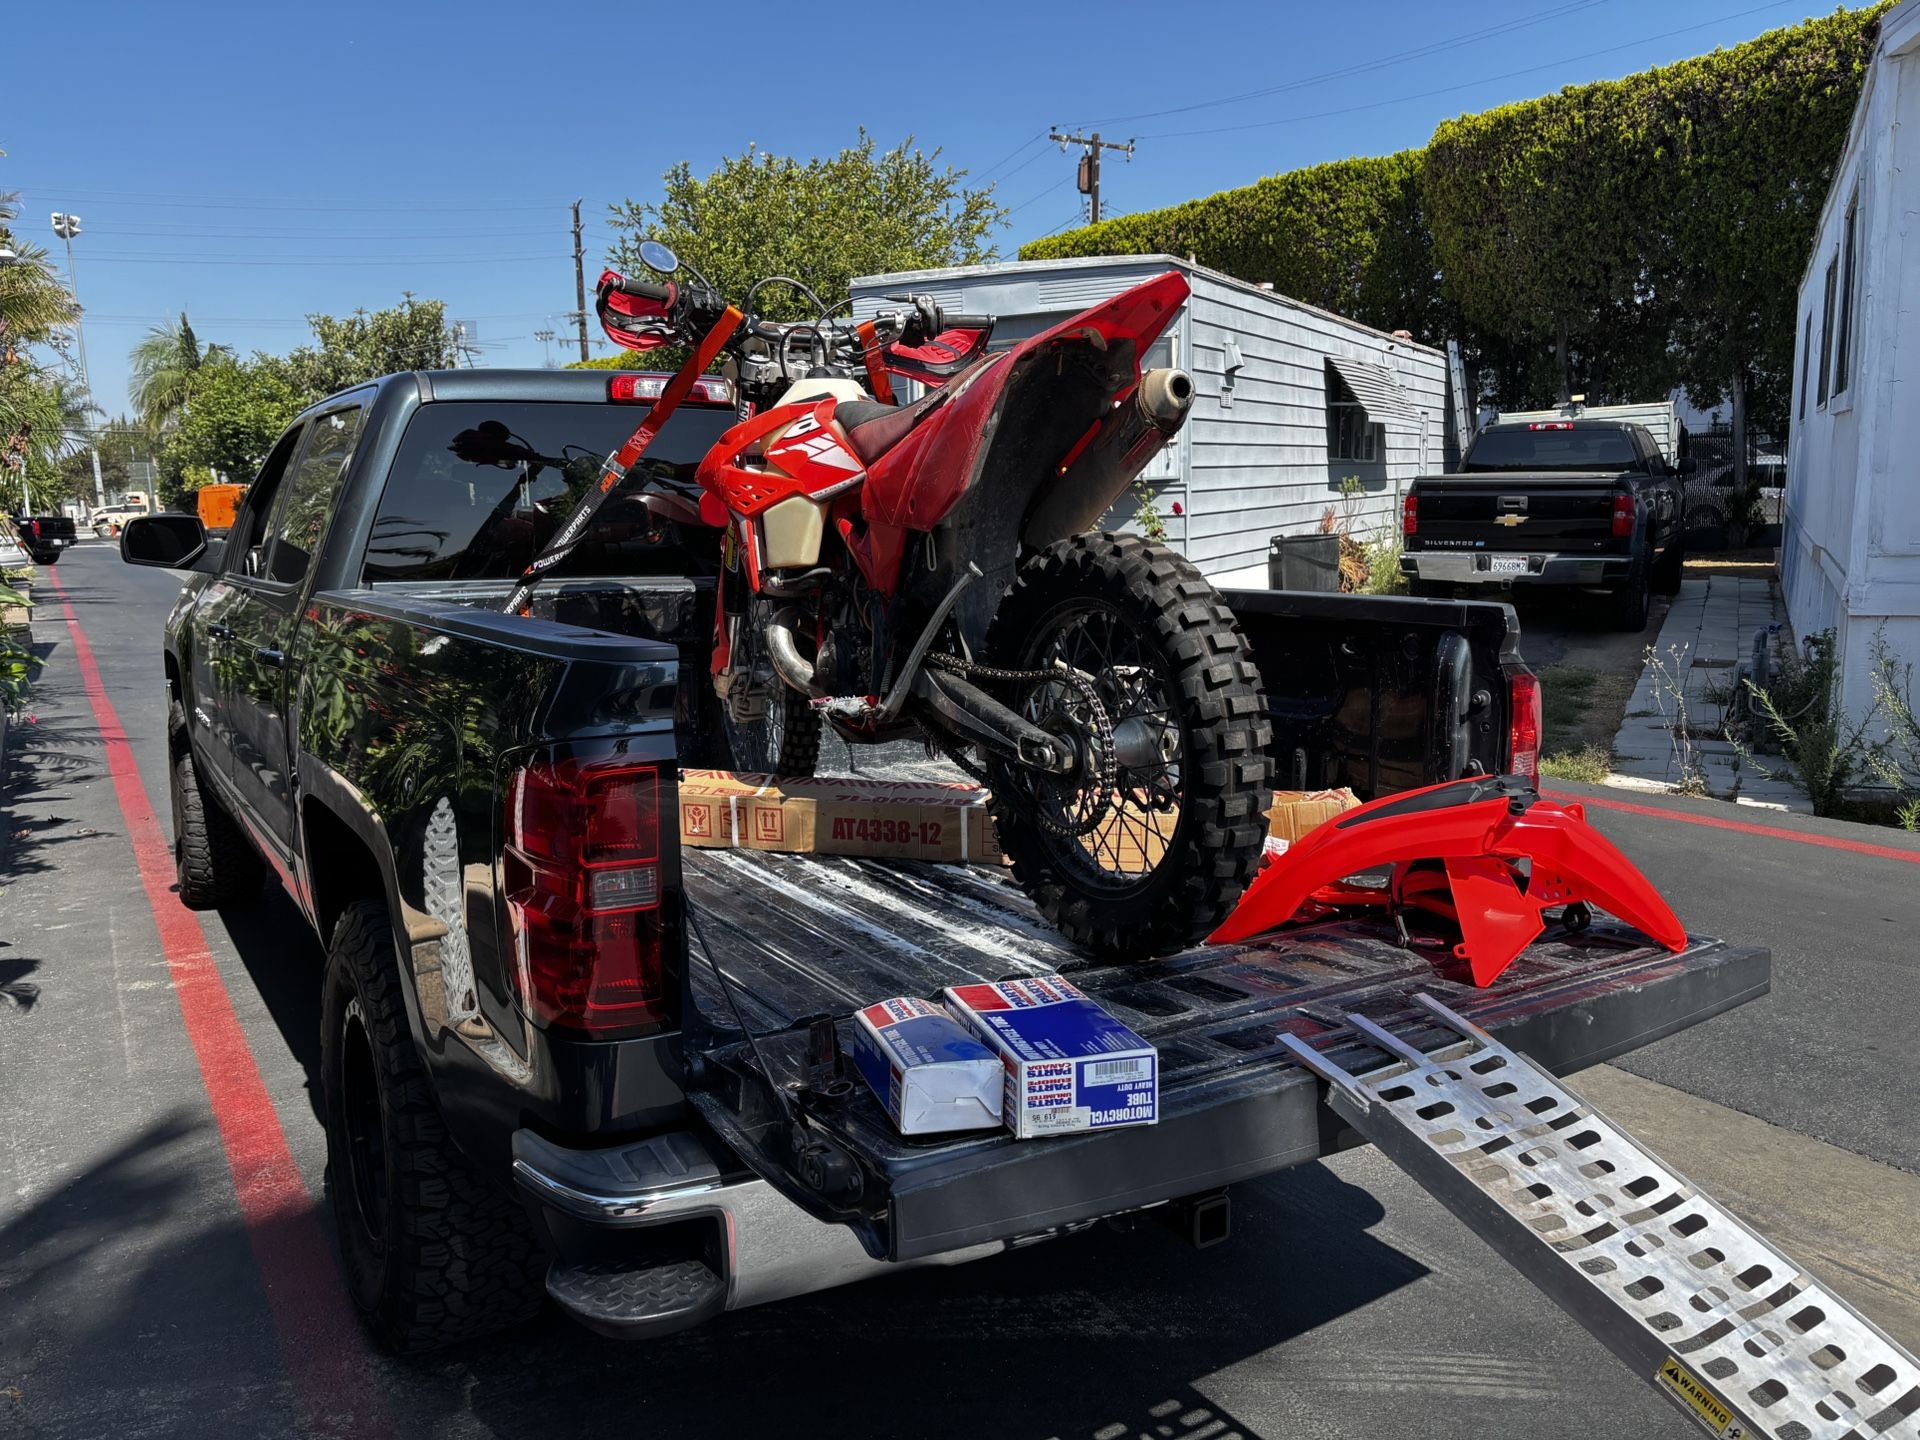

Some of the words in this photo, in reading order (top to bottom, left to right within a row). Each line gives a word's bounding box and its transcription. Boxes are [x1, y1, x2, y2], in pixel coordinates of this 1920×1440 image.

[832, 817, 942, 845] AT4338-12
[1021, 980, 1054, 1004] PARTS
[1045, 976, 1077, 999] PARTS
[995, 982, 1028, 1008] PARTS
[886, 1000, 909, 1020] PARTS
[987, 1016, 1011, 1028] TUBE
[1000, 1027, 1043, 1060] MOTORCYCLE
[1027, 1062, 1072, 1070] CANADA
[1027, 1068, 1072, 1078] PARTS
[1027, 1078, 1072, 1086] EUROPE
[1028, 1082, 1072, 1093] PARTS
[1117, 1083, 1133, 1092] DUTY
[1134, 1082, 1153, 1090] HEAVY
[1027, 1092, 1072, 1101] UNLIMITED
[1028, 1098, 1072, 1108] PARTS
[1127, 1092, 1153, 1106] TUBE
[1091, 1106, 1153, 1125] MOTORCYCL
[1680, 1377, 1727, 1424] WARNING
